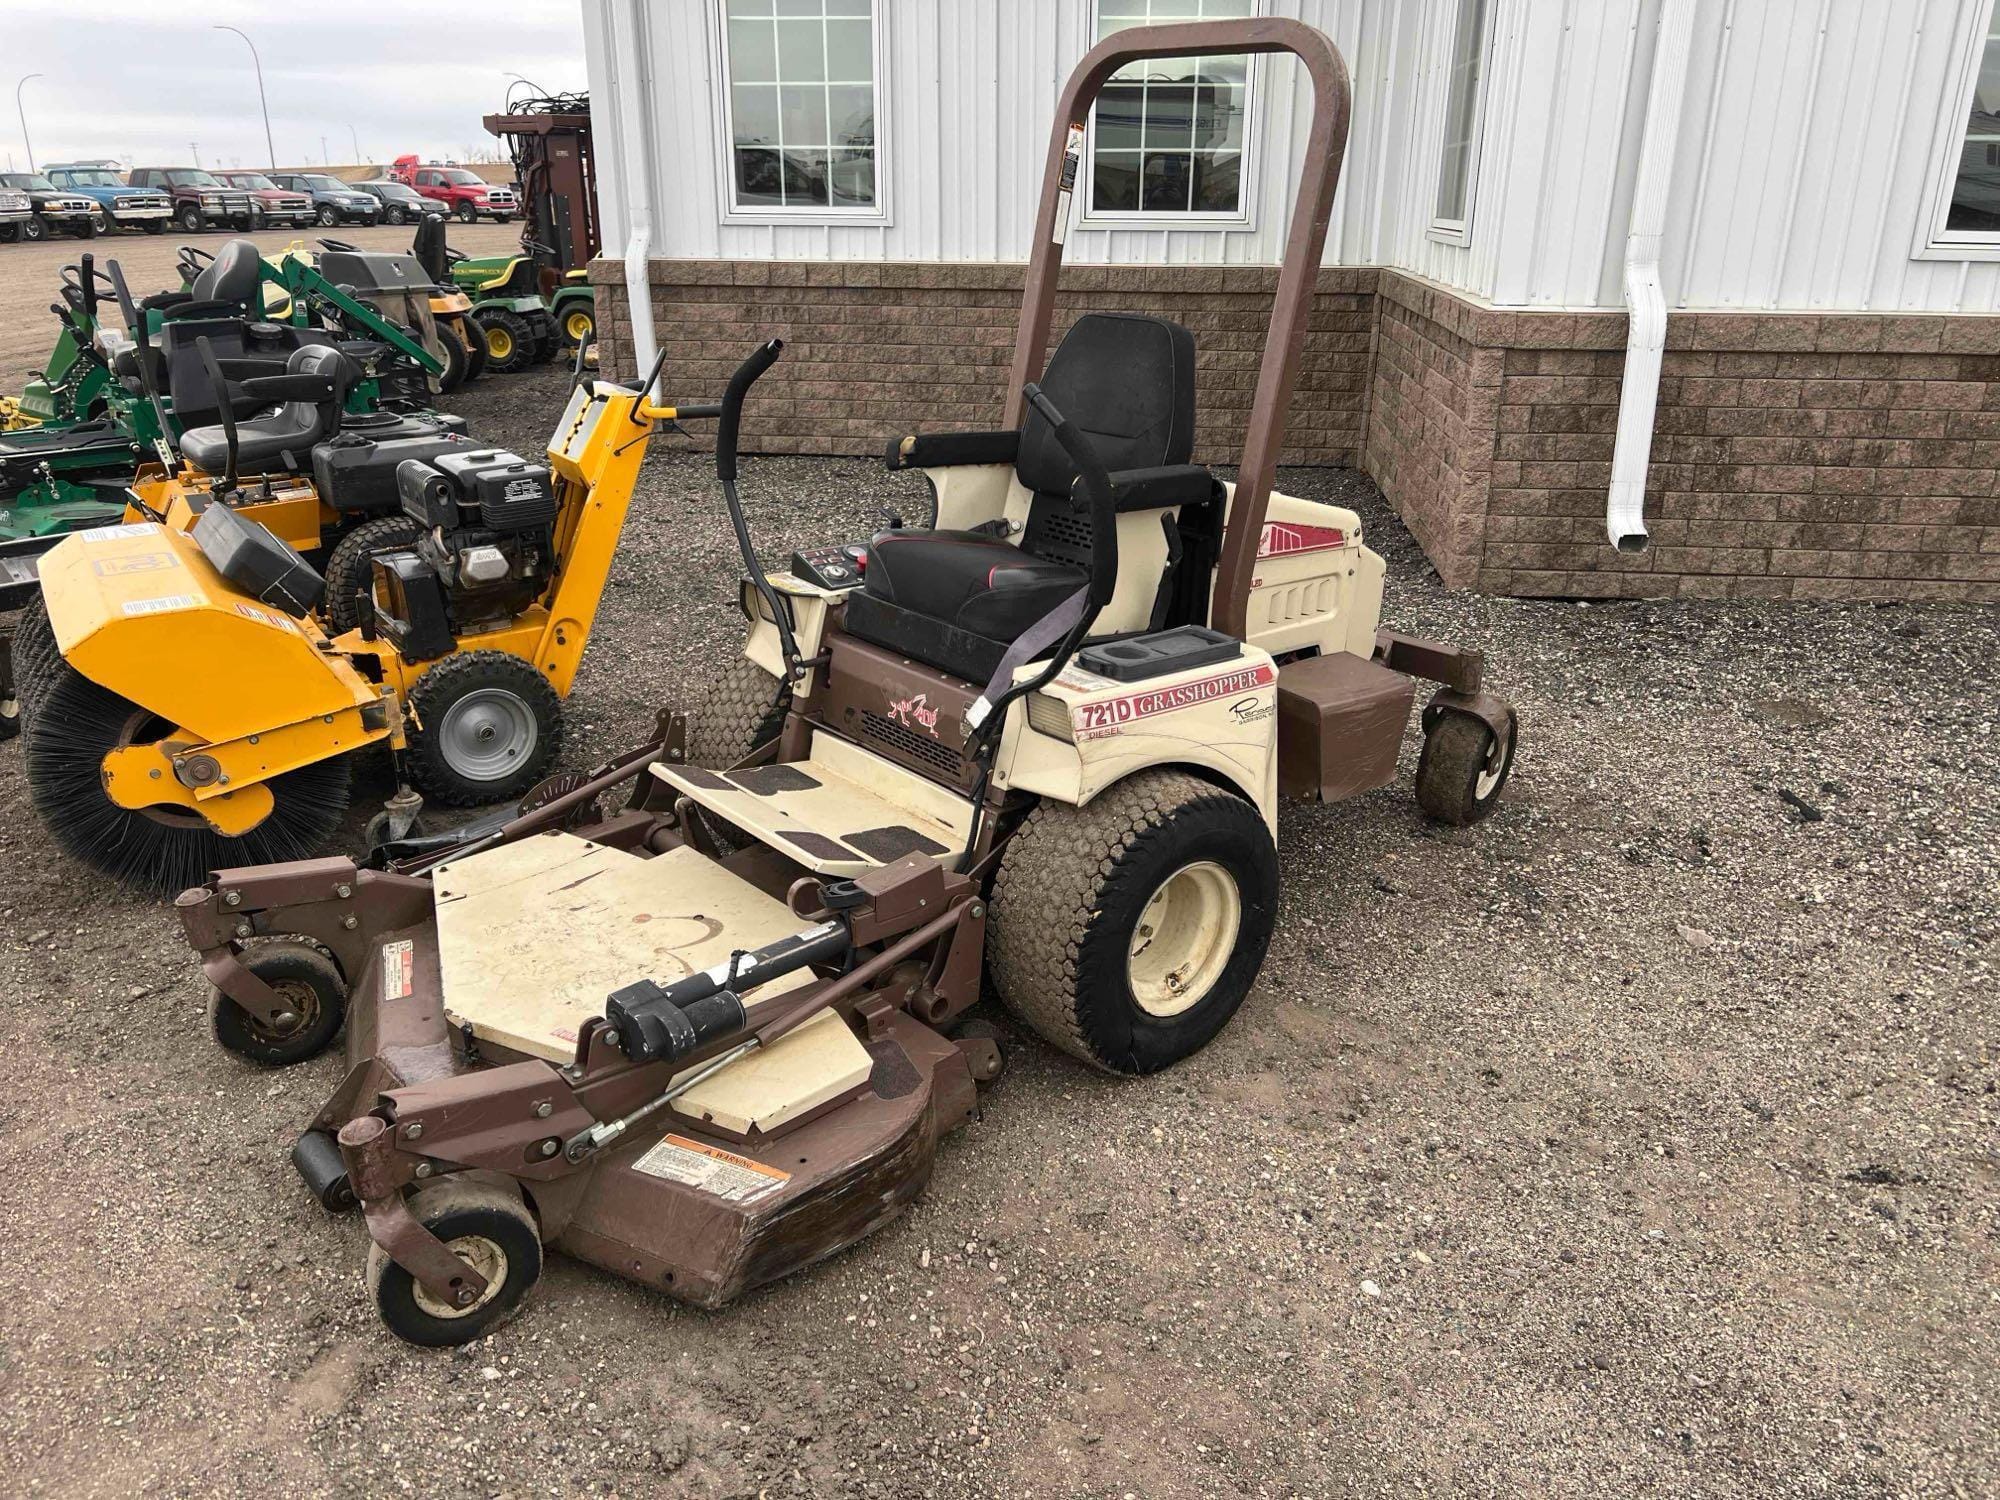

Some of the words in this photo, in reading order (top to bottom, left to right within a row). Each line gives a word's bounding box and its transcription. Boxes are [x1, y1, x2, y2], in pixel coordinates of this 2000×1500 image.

[1082, 701, 1132, 727] 721D
[1139, 670, 1259, 714] GRASSHOPPER
[1089, 727, 1124, 740] DIESEL
[716, 1151, 754, 1170] WARNING
